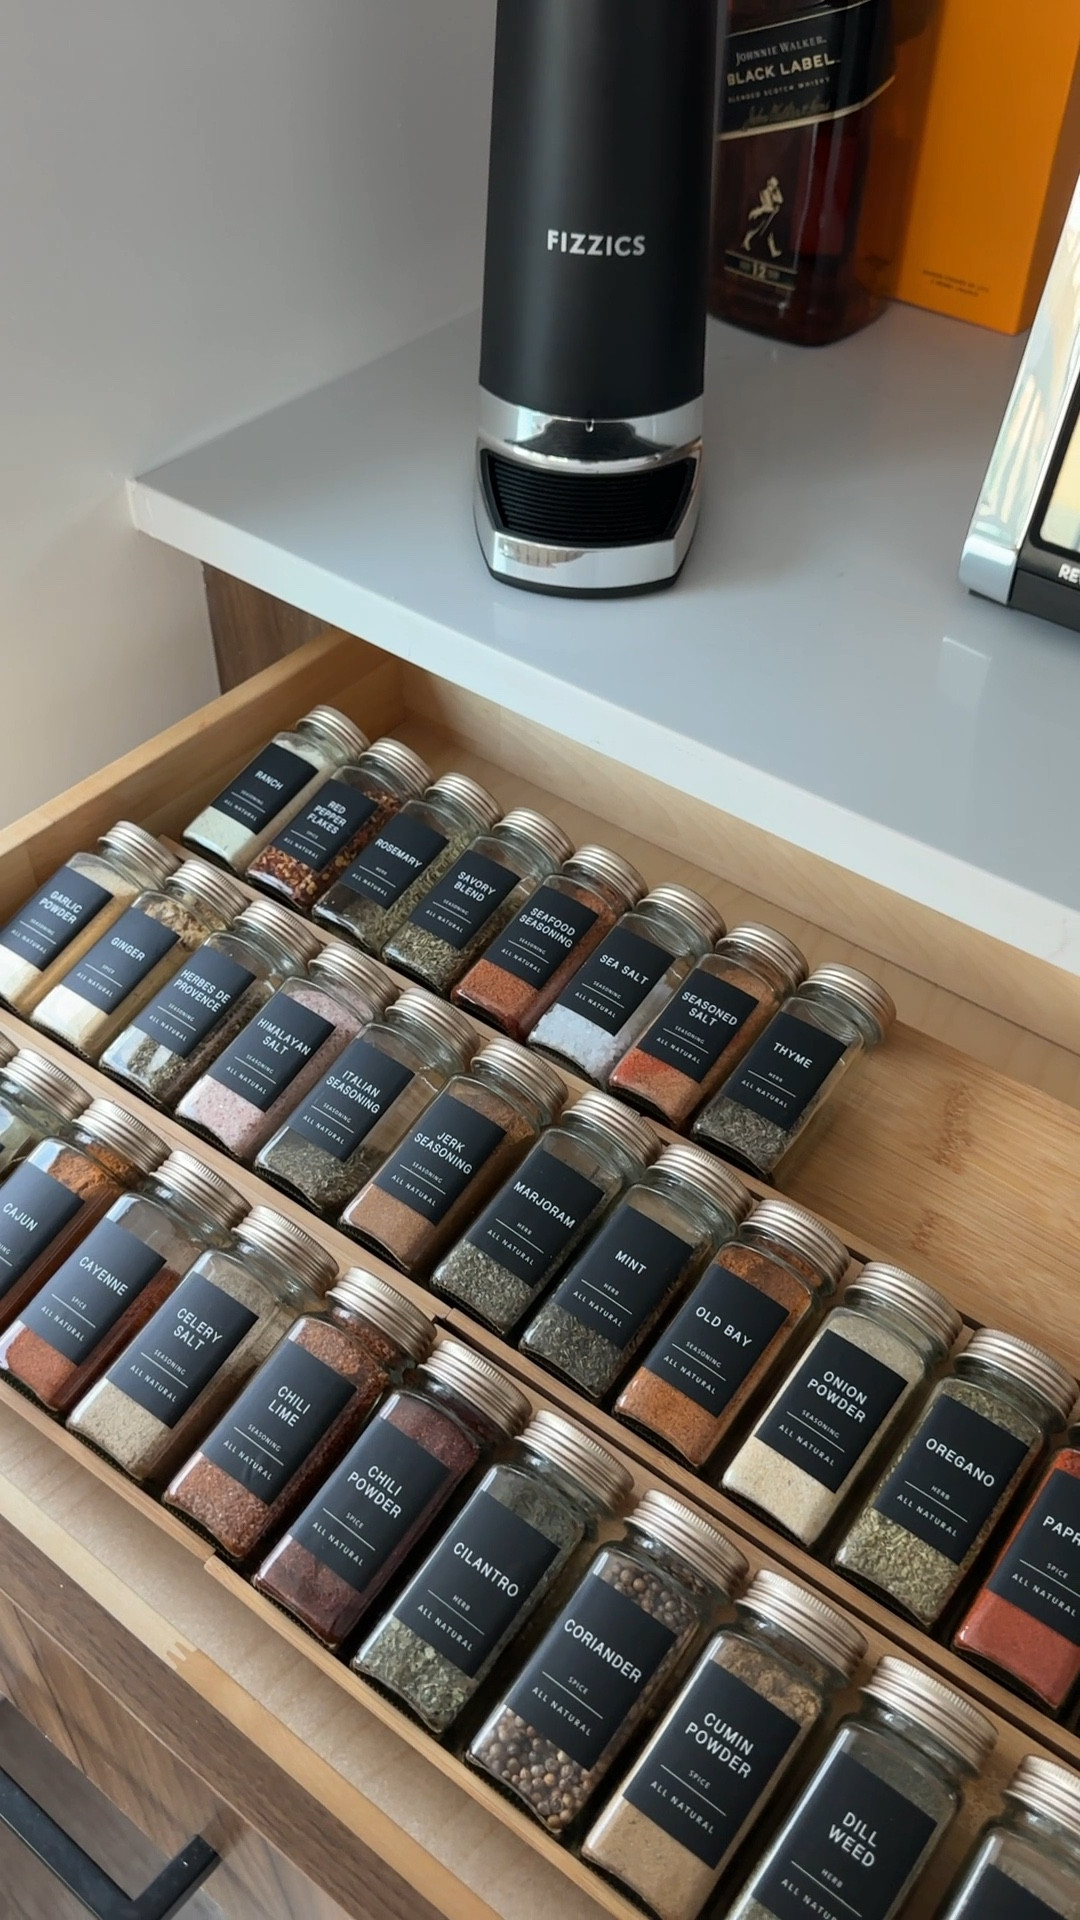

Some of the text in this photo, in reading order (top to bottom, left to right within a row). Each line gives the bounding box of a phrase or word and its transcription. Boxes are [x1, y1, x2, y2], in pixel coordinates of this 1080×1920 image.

[726, 65, 776, 87] BLACK
[547, 229, 646, 257] FIZZICS
[1058, 563, 1080, 584] RE
[255, 770, 283, 790] RANCH
[224, 799, 256, 821] ALL NATURAL
[313, 805, 347, 827] PEPPER
[327, 801, 346, 814] RED
[307, 813, 339, 834] FLAKES
[283, 837, 318, 859] ALL NATURAL
[375, 838, 422, 868] ROSEMARY
[352, 873, 387, 896] ALL NATURAL
[454, 881, 485, 902] BLEND
[458, 871, 496, 895] SAVORY
[39, 898, 77, 924] POWDER
[50, 891, 82, 914] GARLIC
[443, 899, 469, 915] SEASONING
[437, 916, 463, 933] NATURAL
[519, 914, 573, 948] SEASONING
[530, 908, 575, 936] SEAFOOD
[11, 929, 47, 954] ALL NATURAL
[111, 937, 145, 961] GINGER
[519, 937, 546, 955] SEASONING
[501, 948, 540, 973] ALL NATURAL
[600, 955, 648, 984] SEA SALT
[76, 972, 113, 997] ALL NATURAL
[173, 979, 221, 1012] PROVENCE
[180, 969, 231, 1004] HERBES DE
[593, 981, 621, 999] SEASONING
[168, 1003, 194, 1022] SEASONING
[575, 992, 615, 1018] ALL NATURAL
[682, 992, 737, 1025] SEASONED
[688, 1008, 717, 1026] SALT
[149, 1015, 187, 1041] ALL NATURAL
[257, 1018, 311, 1056] HIMALAYAN
[675, 1025, 704, 1044] SEASONING
[262, 1036, 288, 1055] SALT
[656, 1037, 700, 1064] ALL NATURAL
[774, 1042, 812, 1068] THYME
[246, 1054, 273, 1074] SEASONING
[768, 1072, 783, 1083] HERB
[226, 1066, 266, 1094] ALL NATURAL
[342, 1070, 380, 1098] ITALIAN
[326, 1076, 380, 1114] SEASONING
[741, 1080, 787, 1108] ALL NATURAL
[323, 1103, 351, 1123] SEASONING
[303, 1115, 344, 1144] ALL NATURAL
[437, 1132, 465, 1153] JERK
[414, 1133, 472, 1174] SEASONING
[412, 1161, 443, 1183] SEASONING
[391, 1175, 436, 1206] ALL NATURAL
[3, 1203, 38, 1231] CAJUN
[513, 1181, 575, 1228] MARJORAM
[517, 1223, 532, 1235] HERB
[487, 1229, 533, 1265] ALL NATURAL
[615, 1250, 647, 1274] MINT
[79, 1257, 128, 1296] CAYENNE
[603, 1283, 619, 1296] HERB
[71, 1296, 87, 1310] SPICE
[573, 1291, 622, 1327] ALL NATURAL
[41, 1306, 84, 1341] ALL NATURAL
[177, 1308, 222, 1343] CELERY
[696, 1306, 752, 1347] OLD BAY
[173, 1325, 205, 1350] SALT
[154, 1349, 186, 1375] SEASONING
[686, 1341, 721, 1368] SEASONING
[130, 1365, 176, 1402] ALL NATURAL
[663, 1356, 715, 1394] ALL NATURAL
[823, 1371, 867, 1405] ONION
[268, 1399, 299, 1427] LIME
[278, 1386, 310, 1414] CHILI
[807, 1378, 865, 1423] POWDER
[248, 1424, 281, 1452] SEASONING
[802, 1410, 839, 1439] SEASONING
[779, 1424, 834, 1466] ALL NATURAL
[223, 1440, 272, 1480] ALL NATURAL
[926, 1438, 994, 1487] OREGANO
[347, 1471, 401, 1518] POWDER
[368, 1466, 402, 1496] CHILI
[931, 1486, 950, 1500] HERB
[346, 1512, 364, 1529] SPICE
[897, 1494, 956, 1537] ALL NATURAL
[312, 1522, 363, 1566] ALL NATURAL
[453, 1542, 518, 1597] CILANTRO
[1047, 1563, 1068, 1579] SPICE
[452, 1595, 470, 1611] HERB
[1012, 1573, 1075, 1616] ALL NATURAL
[417, 1605, 472, 1651] ALL NATURAL
[564, 1619, 641, 1683] CORIANDER
[568, 1676, 588, 1694] SPICE
[532, 1687, 590, 1736] ALL NATURAL
[704, 1713, 753, 1756] CUMIN
[685, 1722, 751, 1778] POWDER
[689, 1770, 710, 1789] SPICE
[650, 1781, 713, 1834] ALL NATURAL
[842, 1812, 877, 1847] DILL
[829, 1824, 875, 1867] WEED
[781, 1879, 799, 1895] ALL
[821, 1869, 843, 1888] HERB
